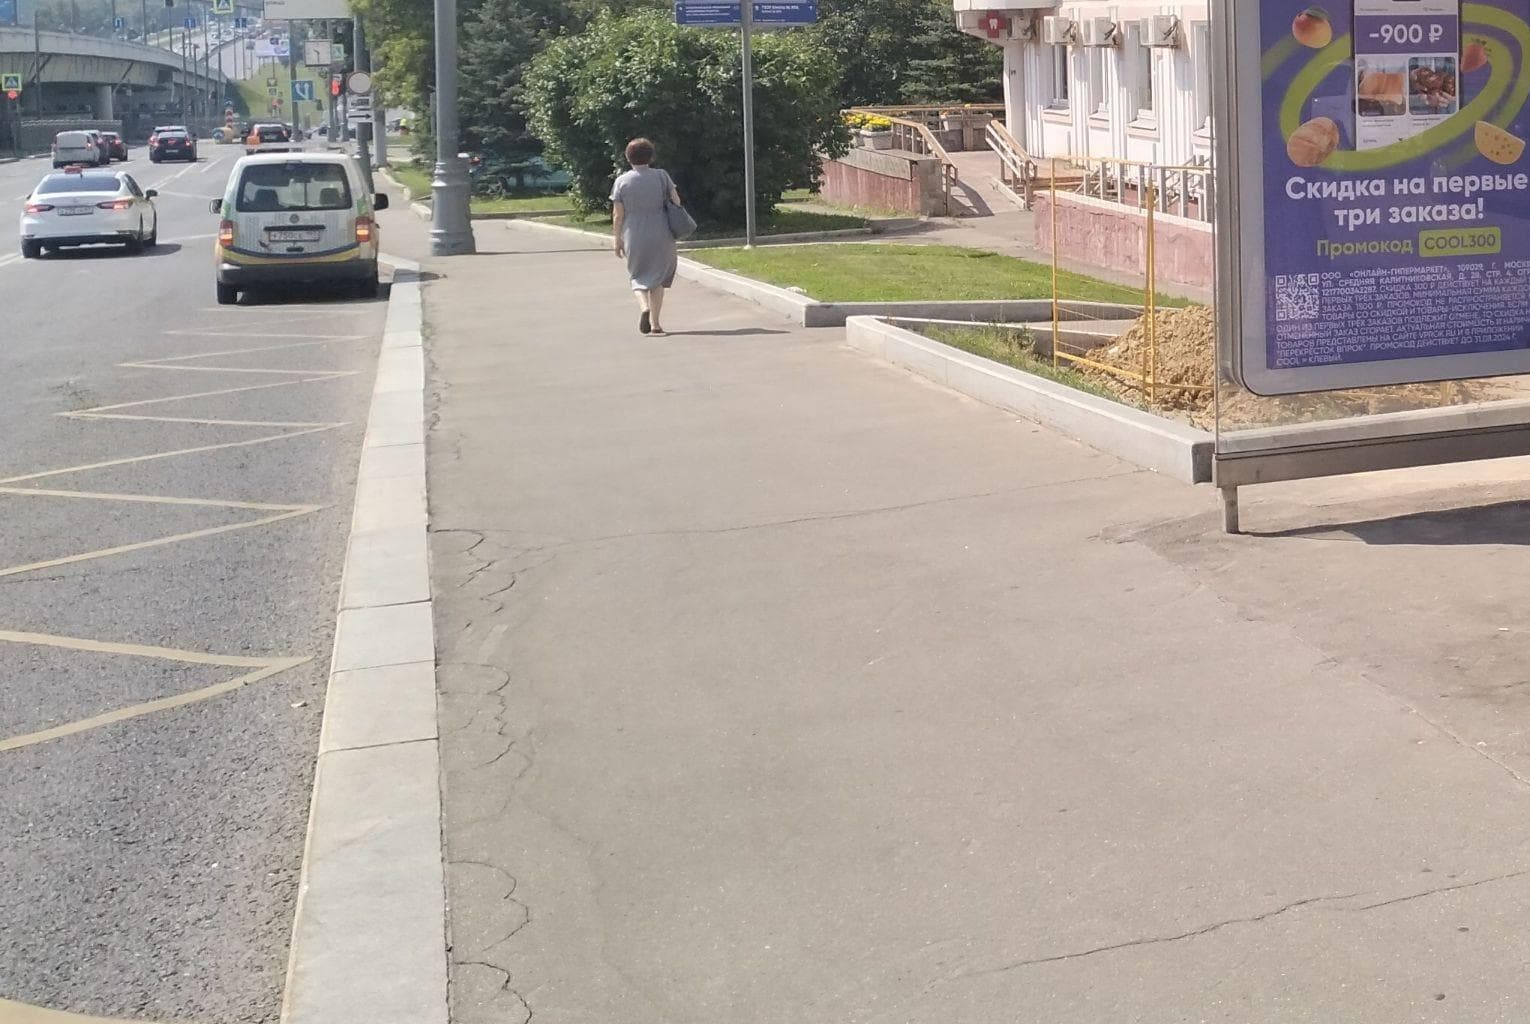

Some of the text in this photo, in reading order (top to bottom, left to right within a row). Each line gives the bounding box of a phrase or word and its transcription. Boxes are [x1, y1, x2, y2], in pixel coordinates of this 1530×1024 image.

[1369, 24, 1424, 44] -900
[1285, 173, 1528, 201] Скидка на первые
[1334, 198, 1484, 231] три заказа!
[1316, 233, 1496, 260] Промокод COOL300
[1321, 271, 1341, 280] ООО
